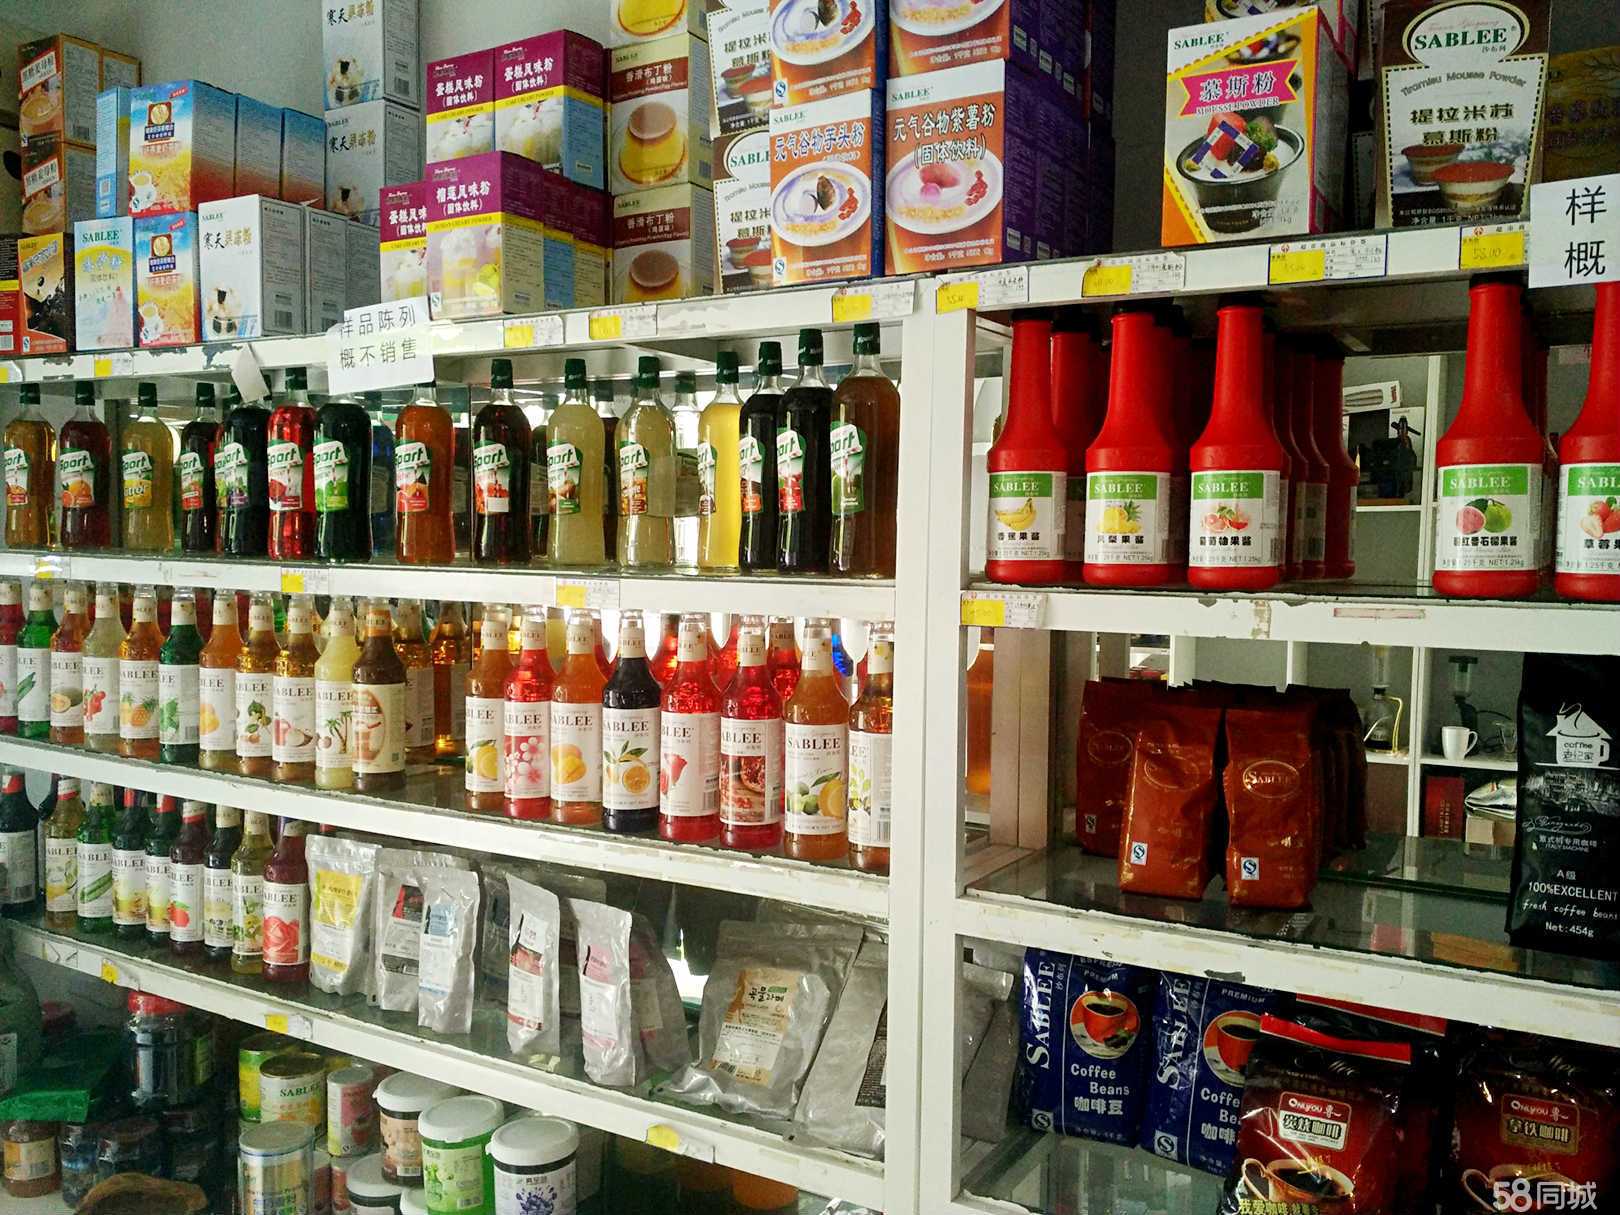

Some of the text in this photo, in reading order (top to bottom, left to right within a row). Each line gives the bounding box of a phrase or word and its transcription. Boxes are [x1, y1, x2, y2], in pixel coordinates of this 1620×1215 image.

[724, 32, 769, 52] 提拉米
[1174, 33, 1225, 50] SABLEE
[1415, 28, 1507, 50] SABLEE
[1200, 71, 1277, 102] 慕斯粉
[1401, 71, 1527, 96] Tiramisu Mousse Powder
[892, 88, 930, 102] SABLEE
[774, 110, 806, 124] SABLEE
[894, 103, 995, 142] 元气谷物紫薯粉
[1410, 103, 1514, 125] 提拉米苏
[775, 121, 865, 161] 元气谷物芋头粉
[1423, 127, 1498, 145] 慕斯粉
[914, 134, 987, 169] (固体饮料)
[436, 180, 491, 203] 榴莲风味粉
[1565, 184, 1607, 226] 样
[389, 205, 427, 224] 蛋糕风味
[730, 208, 770, 224] 提拉米
[82, 231, 120, 243] SABLEE
[1564, 240, 1606, 278] 概
[340, 304, 416, 338] 样品陈列
[340, 337, 417, 371] 概不销售
[994, 481, 1039, 493] SABLEE
[1095, 483, 1144, 494] SABLEE
[1198, 481, 1249, 494] SABLEE
[1450, 477, 1511, 490] SABLEE
[1577, 476, 1620, 488] SABL
[1584, 538, 1620, 549] 草莓果
[52, 660, 81, 670] BLEE
[120, 670, 159, 680] ABLEE
[275, 688, 314, 698] ABLEE
[317, 691, 353, 701] ABLEE
[504, 713, 543, 724] ABLEE
[552, 715, 593, 726] ABLEE
[661, 725, 691, 738] BLEE
[721, 732, 762, 744] ABLEE
[787, 737, 841, 749] SABLEE
[1563, 742, 1593, 750] coffee
[113, 859, 145, 867] ABLEE
[264, 893, 297, 903] ABLEE
[1528, 881, 1618, 902] 100%EXCELLENT
[1522, 899, 1548, 911] fresh
[1554, 904, 1586, 917] coffee
[1545, 921, 1594, 938] Net:454g
[1221, 988, 1266, 1004] PREMIUM
[1026, 962, 1056, 1070] SABLEE
[1071, 1063, 1117, 1080] Coffee
[1089, 1081, 1130, 1096] Beans
[1074, 1096, 1124, 1116] 咖啡豆
[1200, 1088, 1241, 1109] Coffe
[1201, 1122, 1237, 1146] 咖啡
[1283, 1114, 1342, 1140] 炭烧咖啡
[1509, 1119, 1570, 1143] 拿铁咖啡
